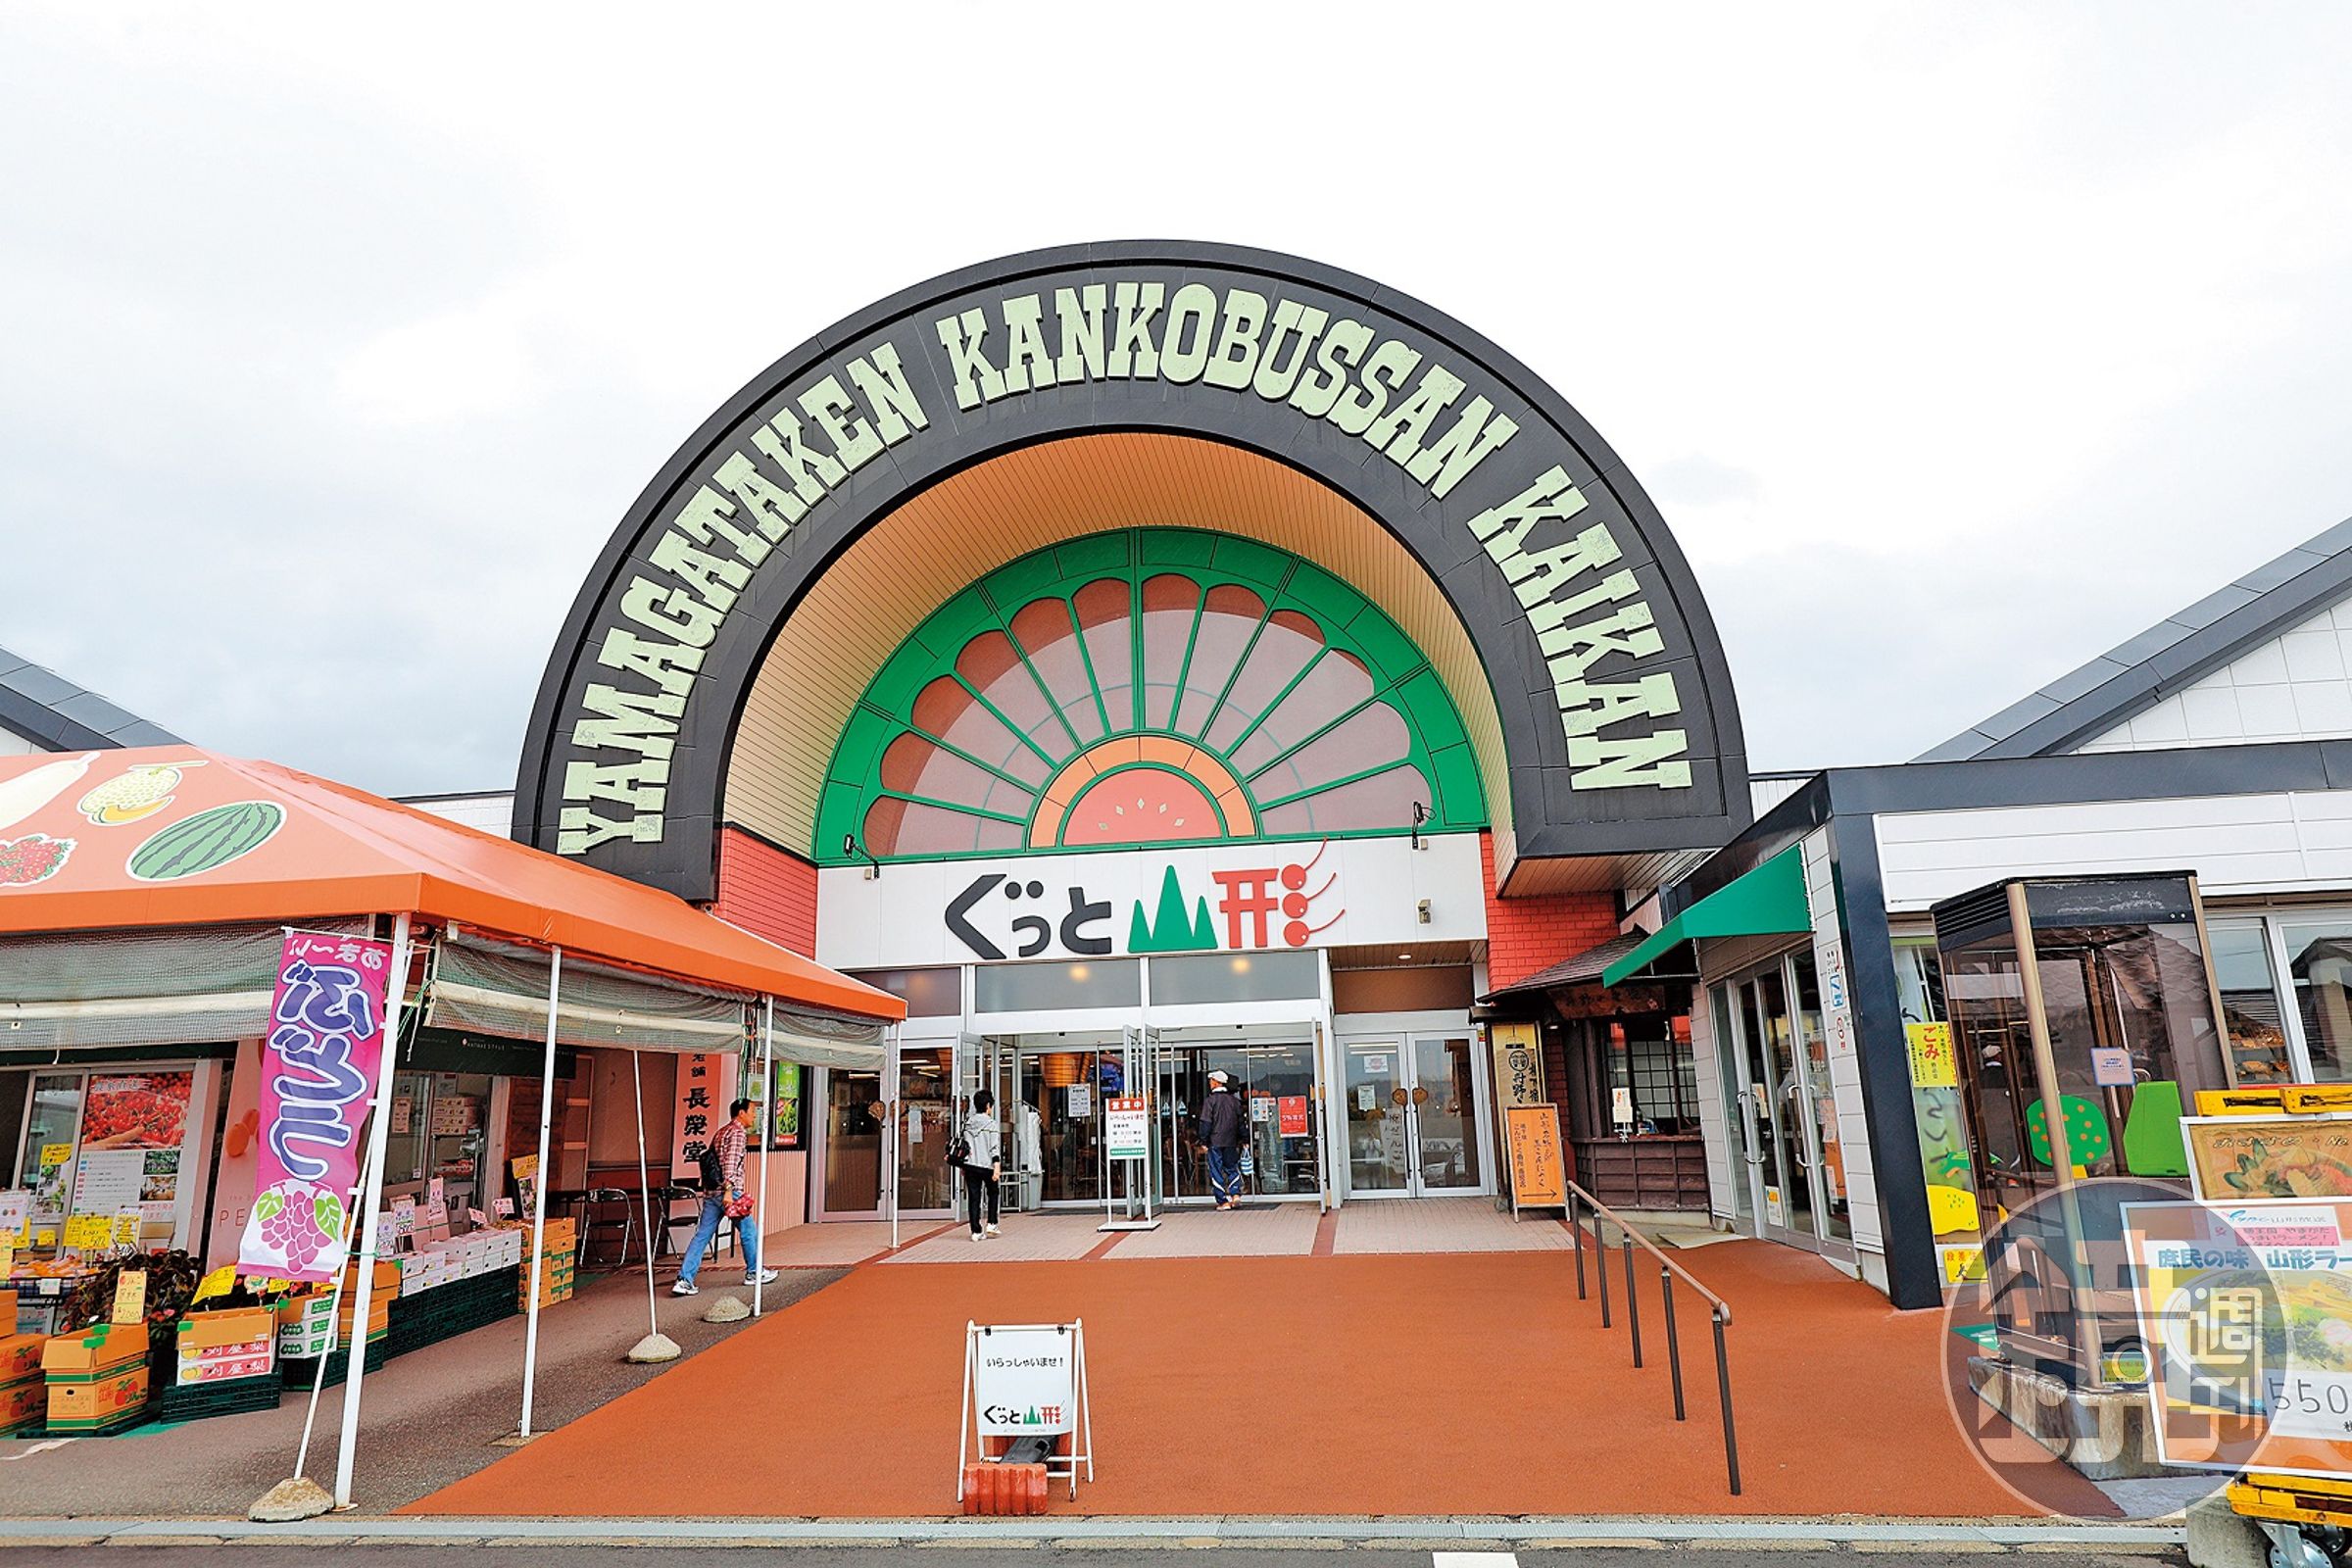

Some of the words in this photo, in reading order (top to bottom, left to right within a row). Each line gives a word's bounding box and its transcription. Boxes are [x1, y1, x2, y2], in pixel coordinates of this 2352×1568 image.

[557, 341, 931, 857] YAMAGATAKEN
[935, 280, 1519, 501] KANKOBUSSAN
[1466, 461, 1695, 793] KAIKAN
[945, 837, 1346, 959] ぐっと山形
[2158, 1249, 2250, 1270] 庶民の味
[984, 1400, 1068, 1425] ぐっと山形
[2268, 1377, 2349, 1414] 550
